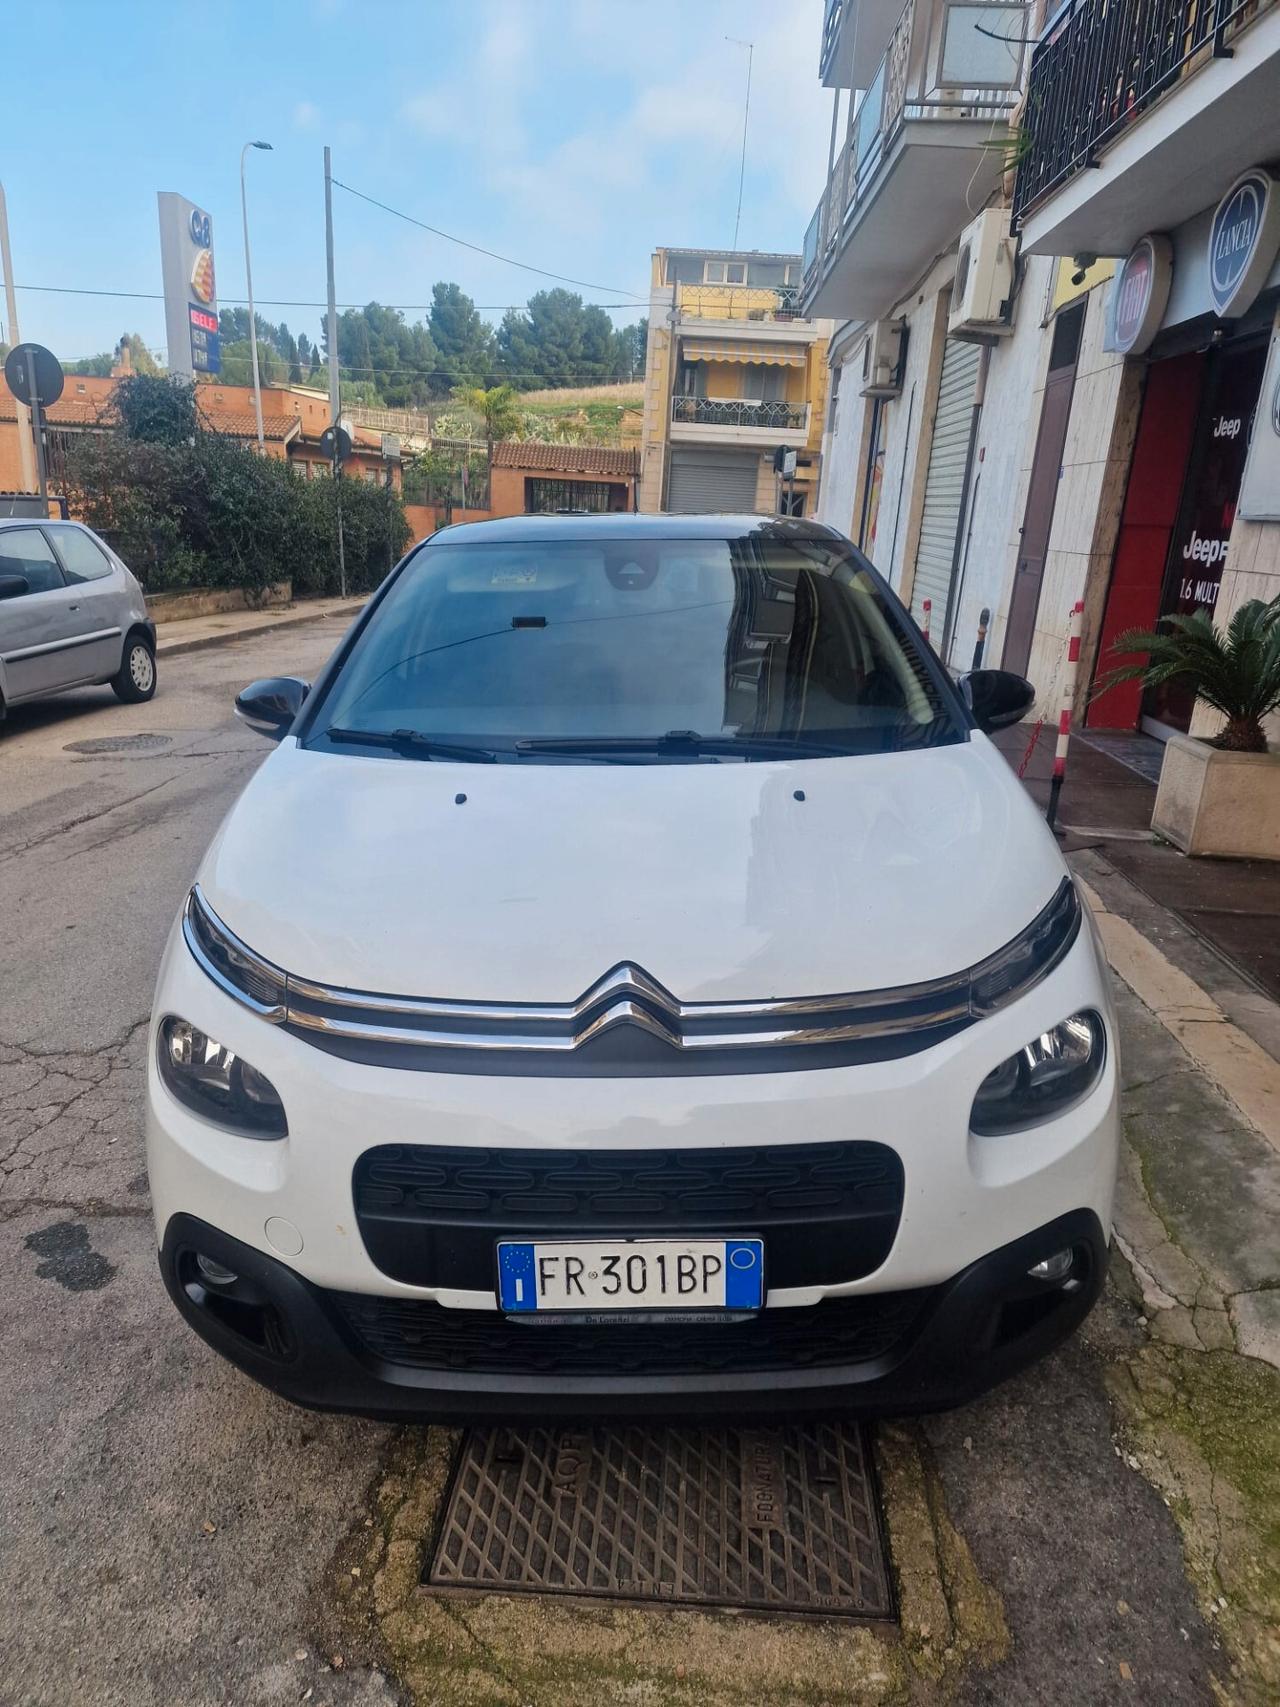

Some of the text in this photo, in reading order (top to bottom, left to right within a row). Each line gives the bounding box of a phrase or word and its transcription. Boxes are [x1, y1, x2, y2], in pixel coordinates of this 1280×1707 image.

[1217, 218, 1252, 260] LANCIA
[1120, 270, 1148, 325] FIAT
[1213, 416, 1241, 439] Jeep
[1179, 578, 1192, 599] 1.6
